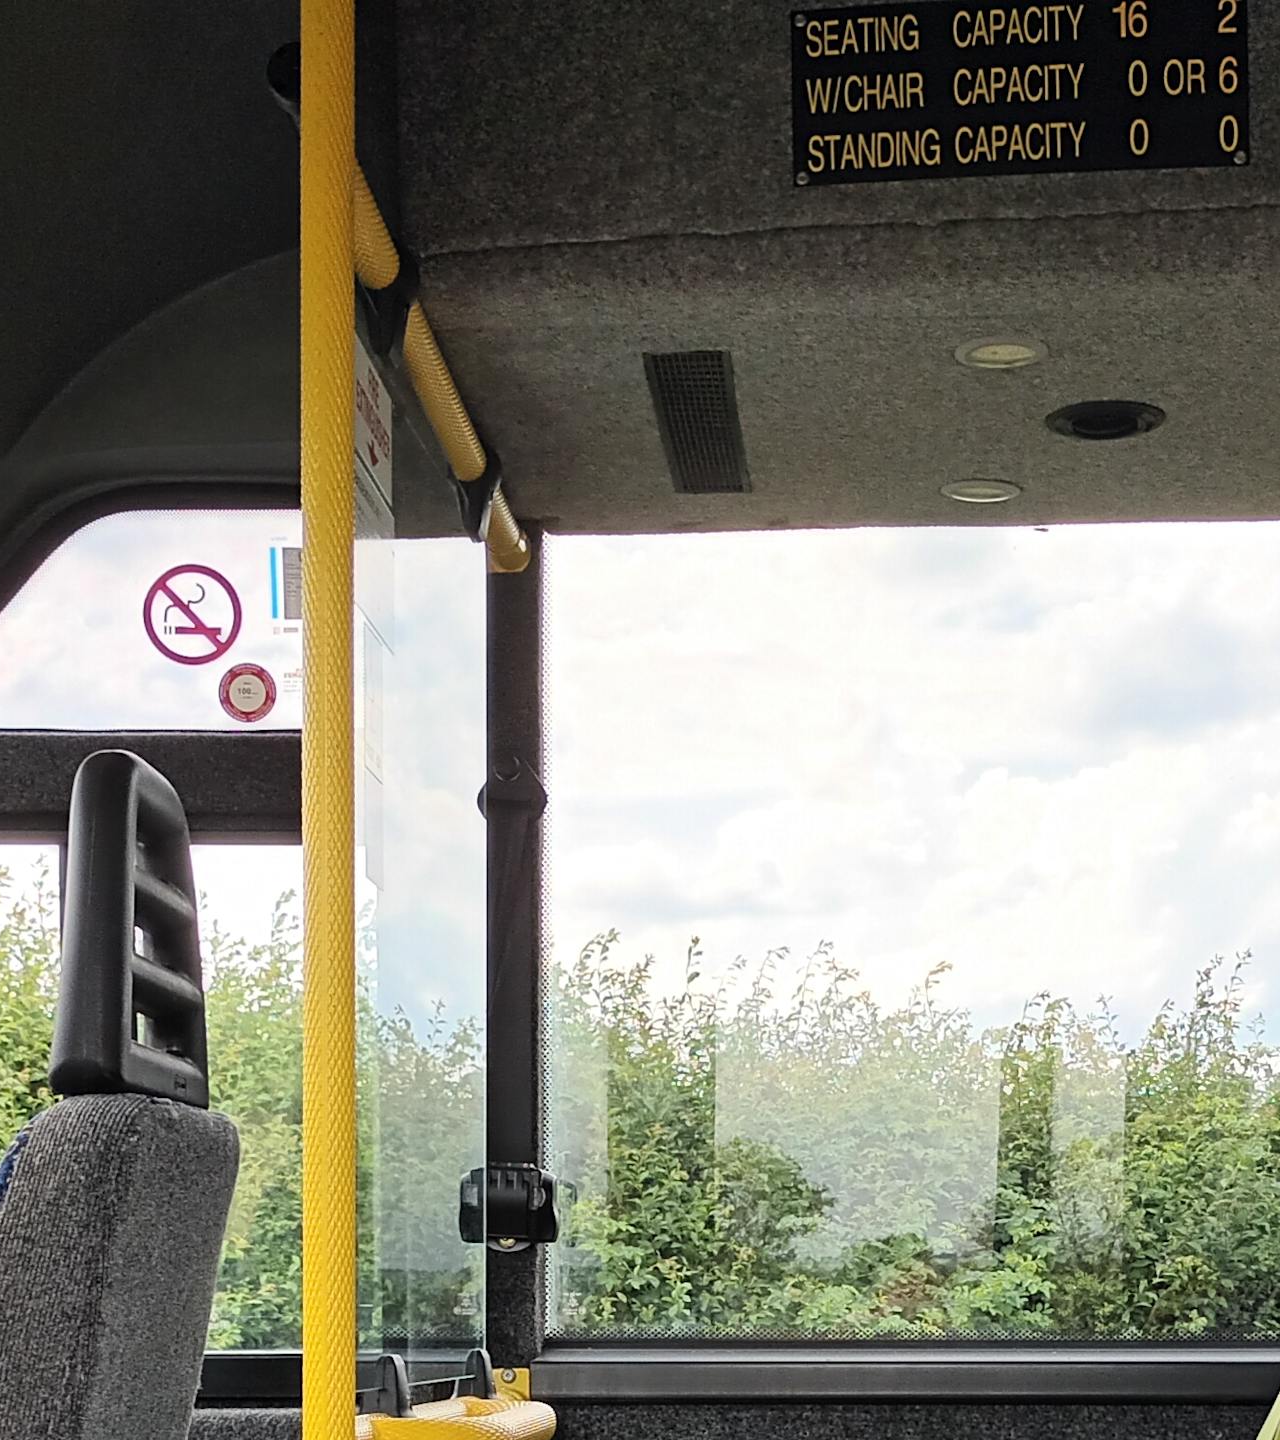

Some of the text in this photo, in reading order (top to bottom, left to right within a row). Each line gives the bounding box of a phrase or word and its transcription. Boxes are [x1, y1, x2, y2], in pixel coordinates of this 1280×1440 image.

[806, 0, 1237, 57] SEATING CAPACITY 16 2
[806, 56, 1238, 114] W/CHAIR CAPACITY 0 OR 6
[808, 115, 1239, 172] STANDING CAPACITY 0 0
